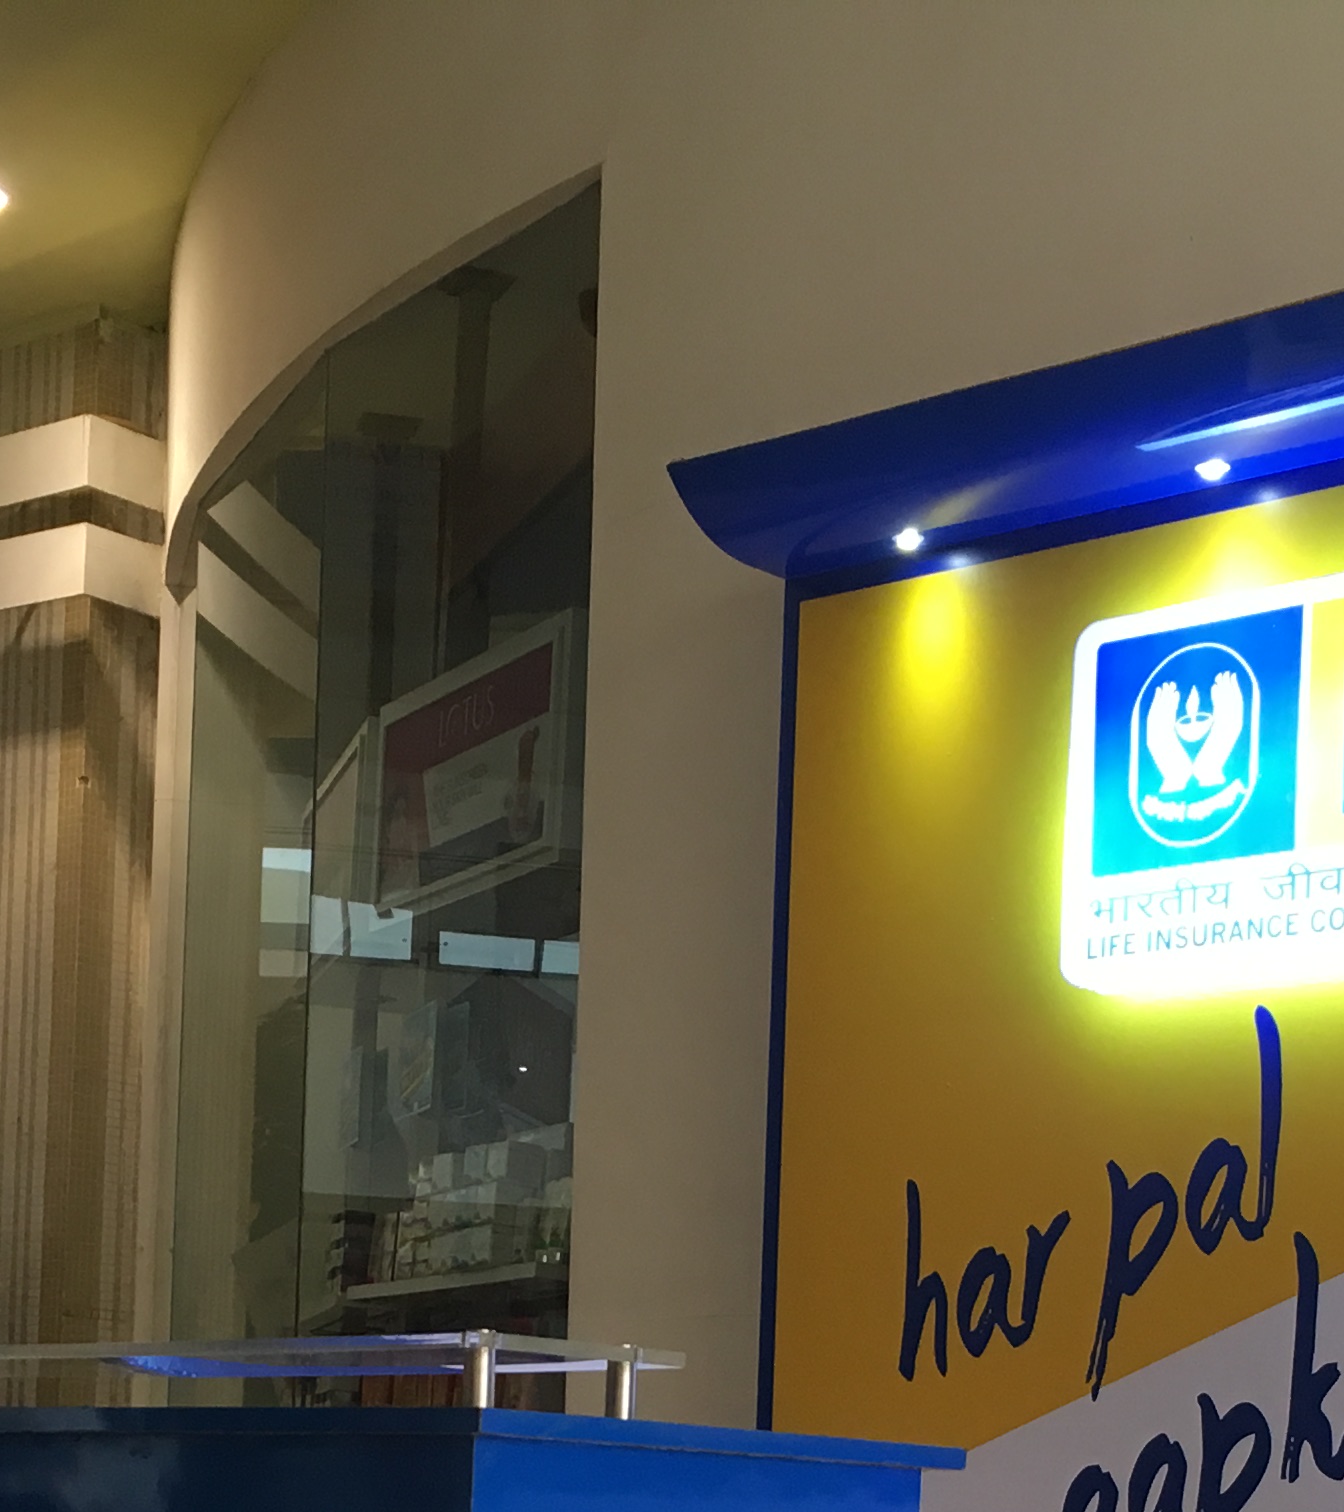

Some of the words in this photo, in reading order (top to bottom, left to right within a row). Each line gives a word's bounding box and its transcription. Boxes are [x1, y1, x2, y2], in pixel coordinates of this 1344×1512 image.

[1090, 877, 1231, 925] भारतीय
[1086, 930, 1135, 961] LIFE
[1147, 913, 1299, 951] INSURANCE
[897, 1179, 1071, 1381] har
[1084, 1005, 1282, 1401] pal
